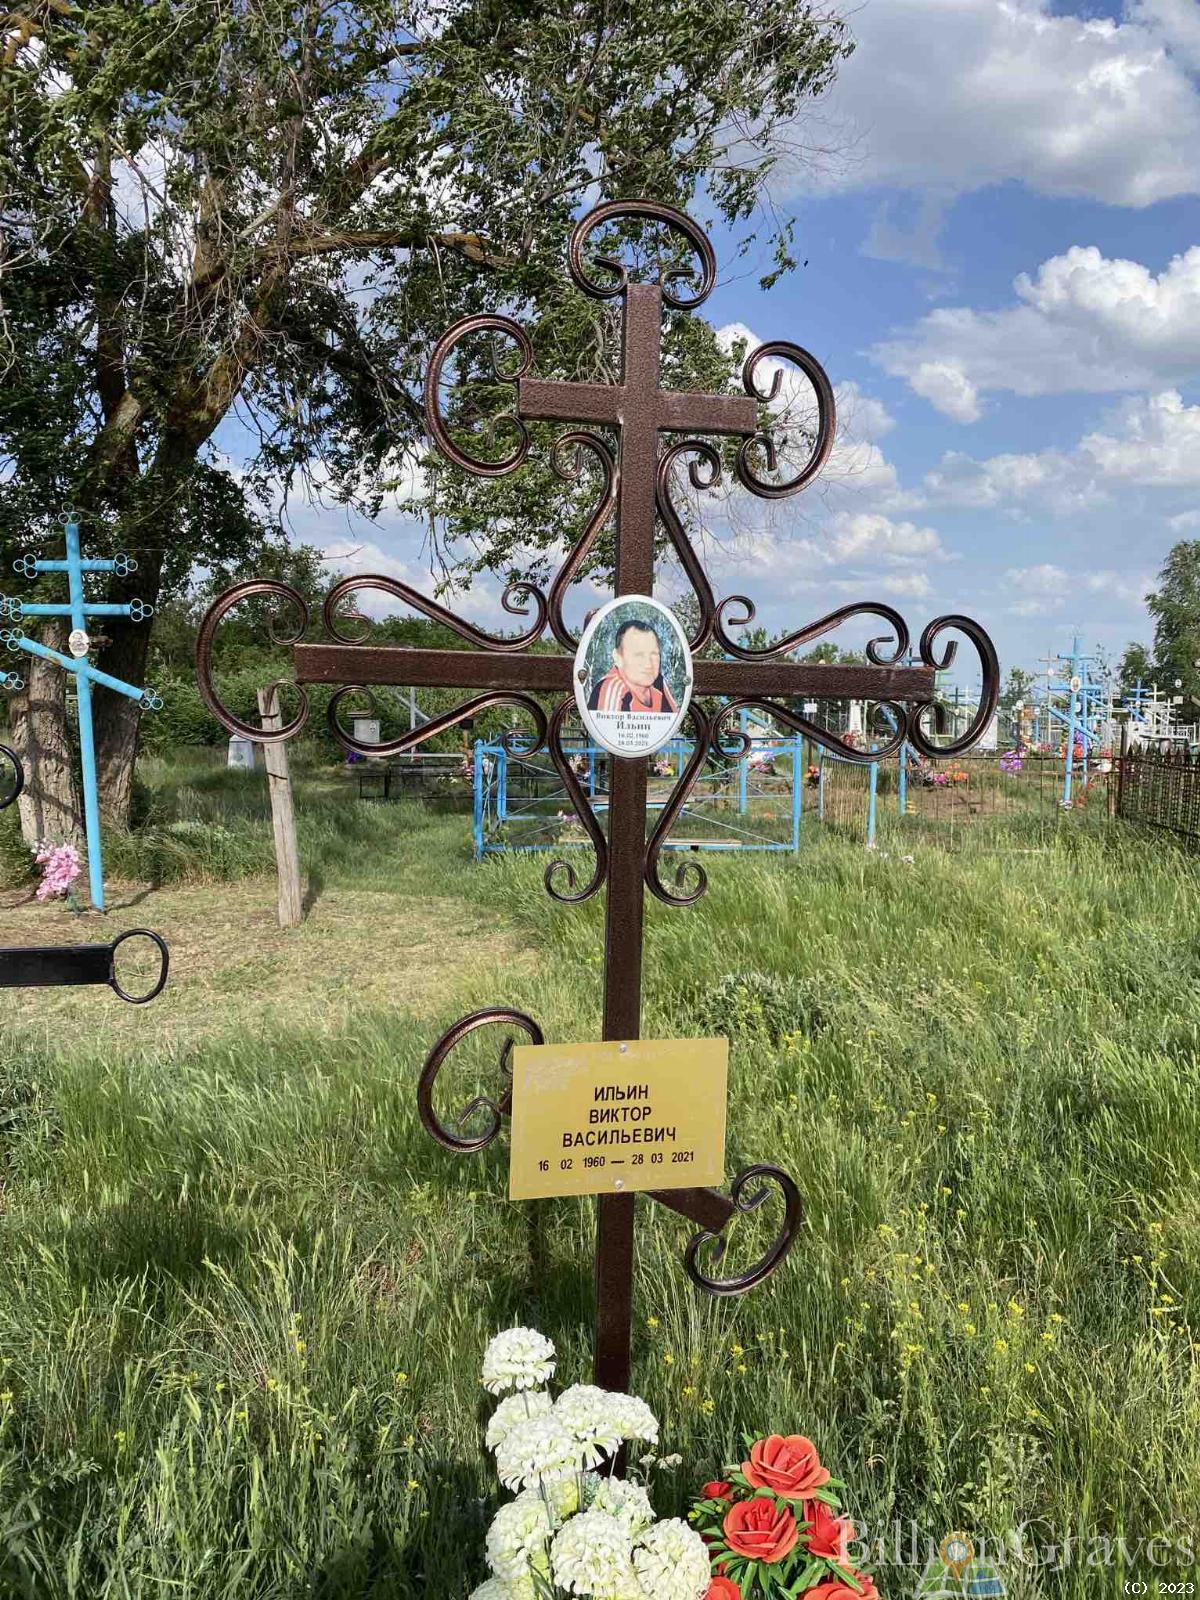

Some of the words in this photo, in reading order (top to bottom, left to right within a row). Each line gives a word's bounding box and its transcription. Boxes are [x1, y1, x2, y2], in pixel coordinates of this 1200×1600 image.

[616, 721, 651, 730] Ильин
[594, 1085, 649, 1101] ИЛЬИН
[589, 1106, 652, 1124] ВИКТОР
[562, 1127, 677, 1148] ВАСИЛЬЕВИЧ
[538, 1160, 549, 1172] 16
[560, 1158, 573, 1170] 02
[583, 1156, 606, 1168] 1960
[631, 1153, 644, 1165] 28
[651, 1152, 663, 1164] 03
[672, 1151, 694, 1163] 2021
